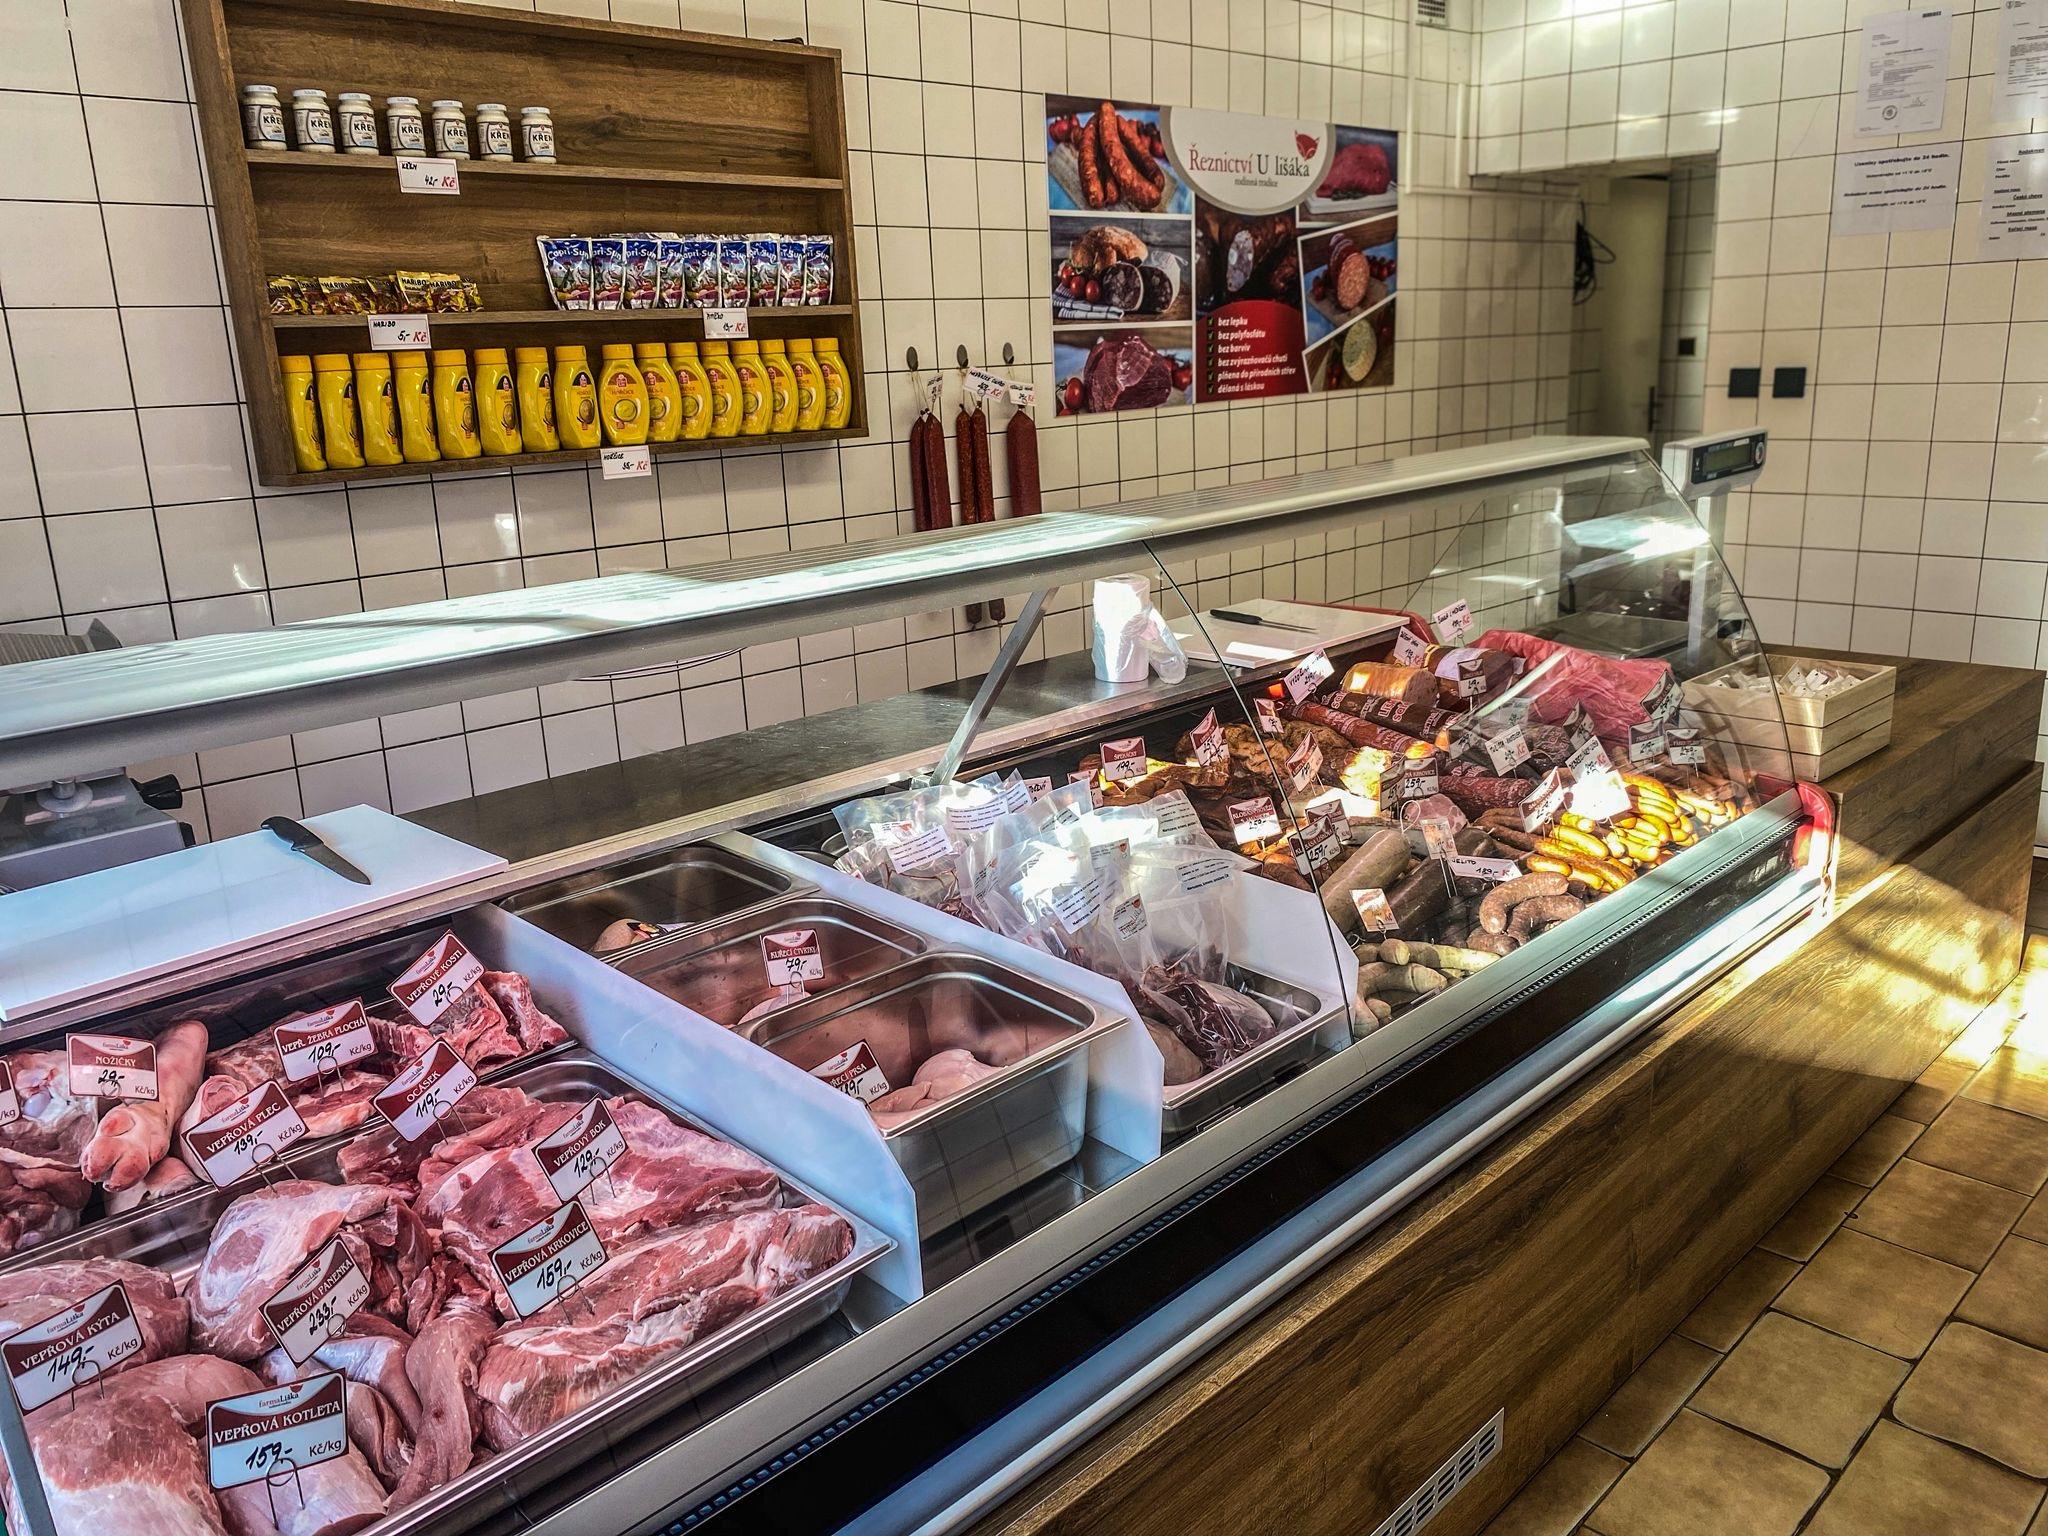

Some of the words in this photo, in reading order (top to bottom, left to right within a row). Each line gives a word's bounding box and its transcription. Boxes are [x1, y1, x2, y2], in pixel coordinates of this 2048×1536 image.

[1188, 143, 1253, 174] Řeznictví
[1257, 154, 1269, 175] U
[1274, 154, 1311, 177] lišáka
[441, 175, 456, 188] Kč
[547, 247, 589, 261] Capri-Sun
[592, 247, 621, 260] pri-Sun
[626, 247, 656, 260] pri-Sun
[401, 278, 427, 287] HARIBO
[1217, 317, 1229, 327] bez
[397, 330, 410, 342] 5,-
[413, 331, 427, 342] Kč
[1217, 331, 1229, 340] bez
[1217, 344, 1229, 354] bez
[1217, 357, 1229, 367] bez
[1240, 370, 1249, 379] do
[636, 461, 649, 470] Kč
[406, 969, 442, 1002] VEPŘOVÉ
[440, 949, 463, 972] KOSTI
[462, 965, 482, 983] Kč/kg
[281, 1038, 306, 1053] VEPŘ.
[307, 1030, 334, 1044] ŽEBRA
[308, 1042, 341, 1063] 109,-
[349, 1043, 373, 1056] Kč/kg
[95, 1056, 137, 1067] NOŽIČKY
[848, 1063, 867, 1078] PRSA
[134, 1085, 156, 1097] Kč/kg
[416, 1087, 441, 1118] 119,-
[453, 1075, 475, 1095] Kč/kg
[869, 1082, 888, 1095] Kč/kg
[206, 1118, 256, 1154] VEPŘOVÁ
[255, 1102, 281, 1123] PLEC
[234, 1130, 263, 1155] 139,-
[277, 1124, 303, 1142] Kč/kg
[553, 1133, 590, 1167] VEPŘOVÝ
[589, 1120, 607, 1138] BOK
[606, 1141, 624, 1158] Kč/kg
[504, 1248, 549, 1282] VEPŘOVÁ
[547, 1221, 589, 1255] KRKOVICE
[536, 1257, 572, 1290] 159,-
[580, 1250, 603, 1270] Kč/kg
[276, 1293, 320, 1332] VEPŘOVÁ
[318, 1258, 353, 1296] PANENKA
[309, 1295, 337, 1336] 233,-
[347, 1284, 368, 1307] Kč/kg
[46, 1311, 84, 1334] farmaLiška
[20, 1332, 85, 1369] VEPŘOVÁ
[86, 1311, 121, 1336] KÝTA
[47, 1345, 95, 1382] 149,-
[107, 1338, 138, 1360] Kč/kg
[258, 1392, 299, 1408] farmaLiška
[214, 1415, 280, 1443] VEPŘOVÁ
[282, 1400, 341, 1427] KOTLETA
[309, 1440, 342, 1457] Kč/kg
